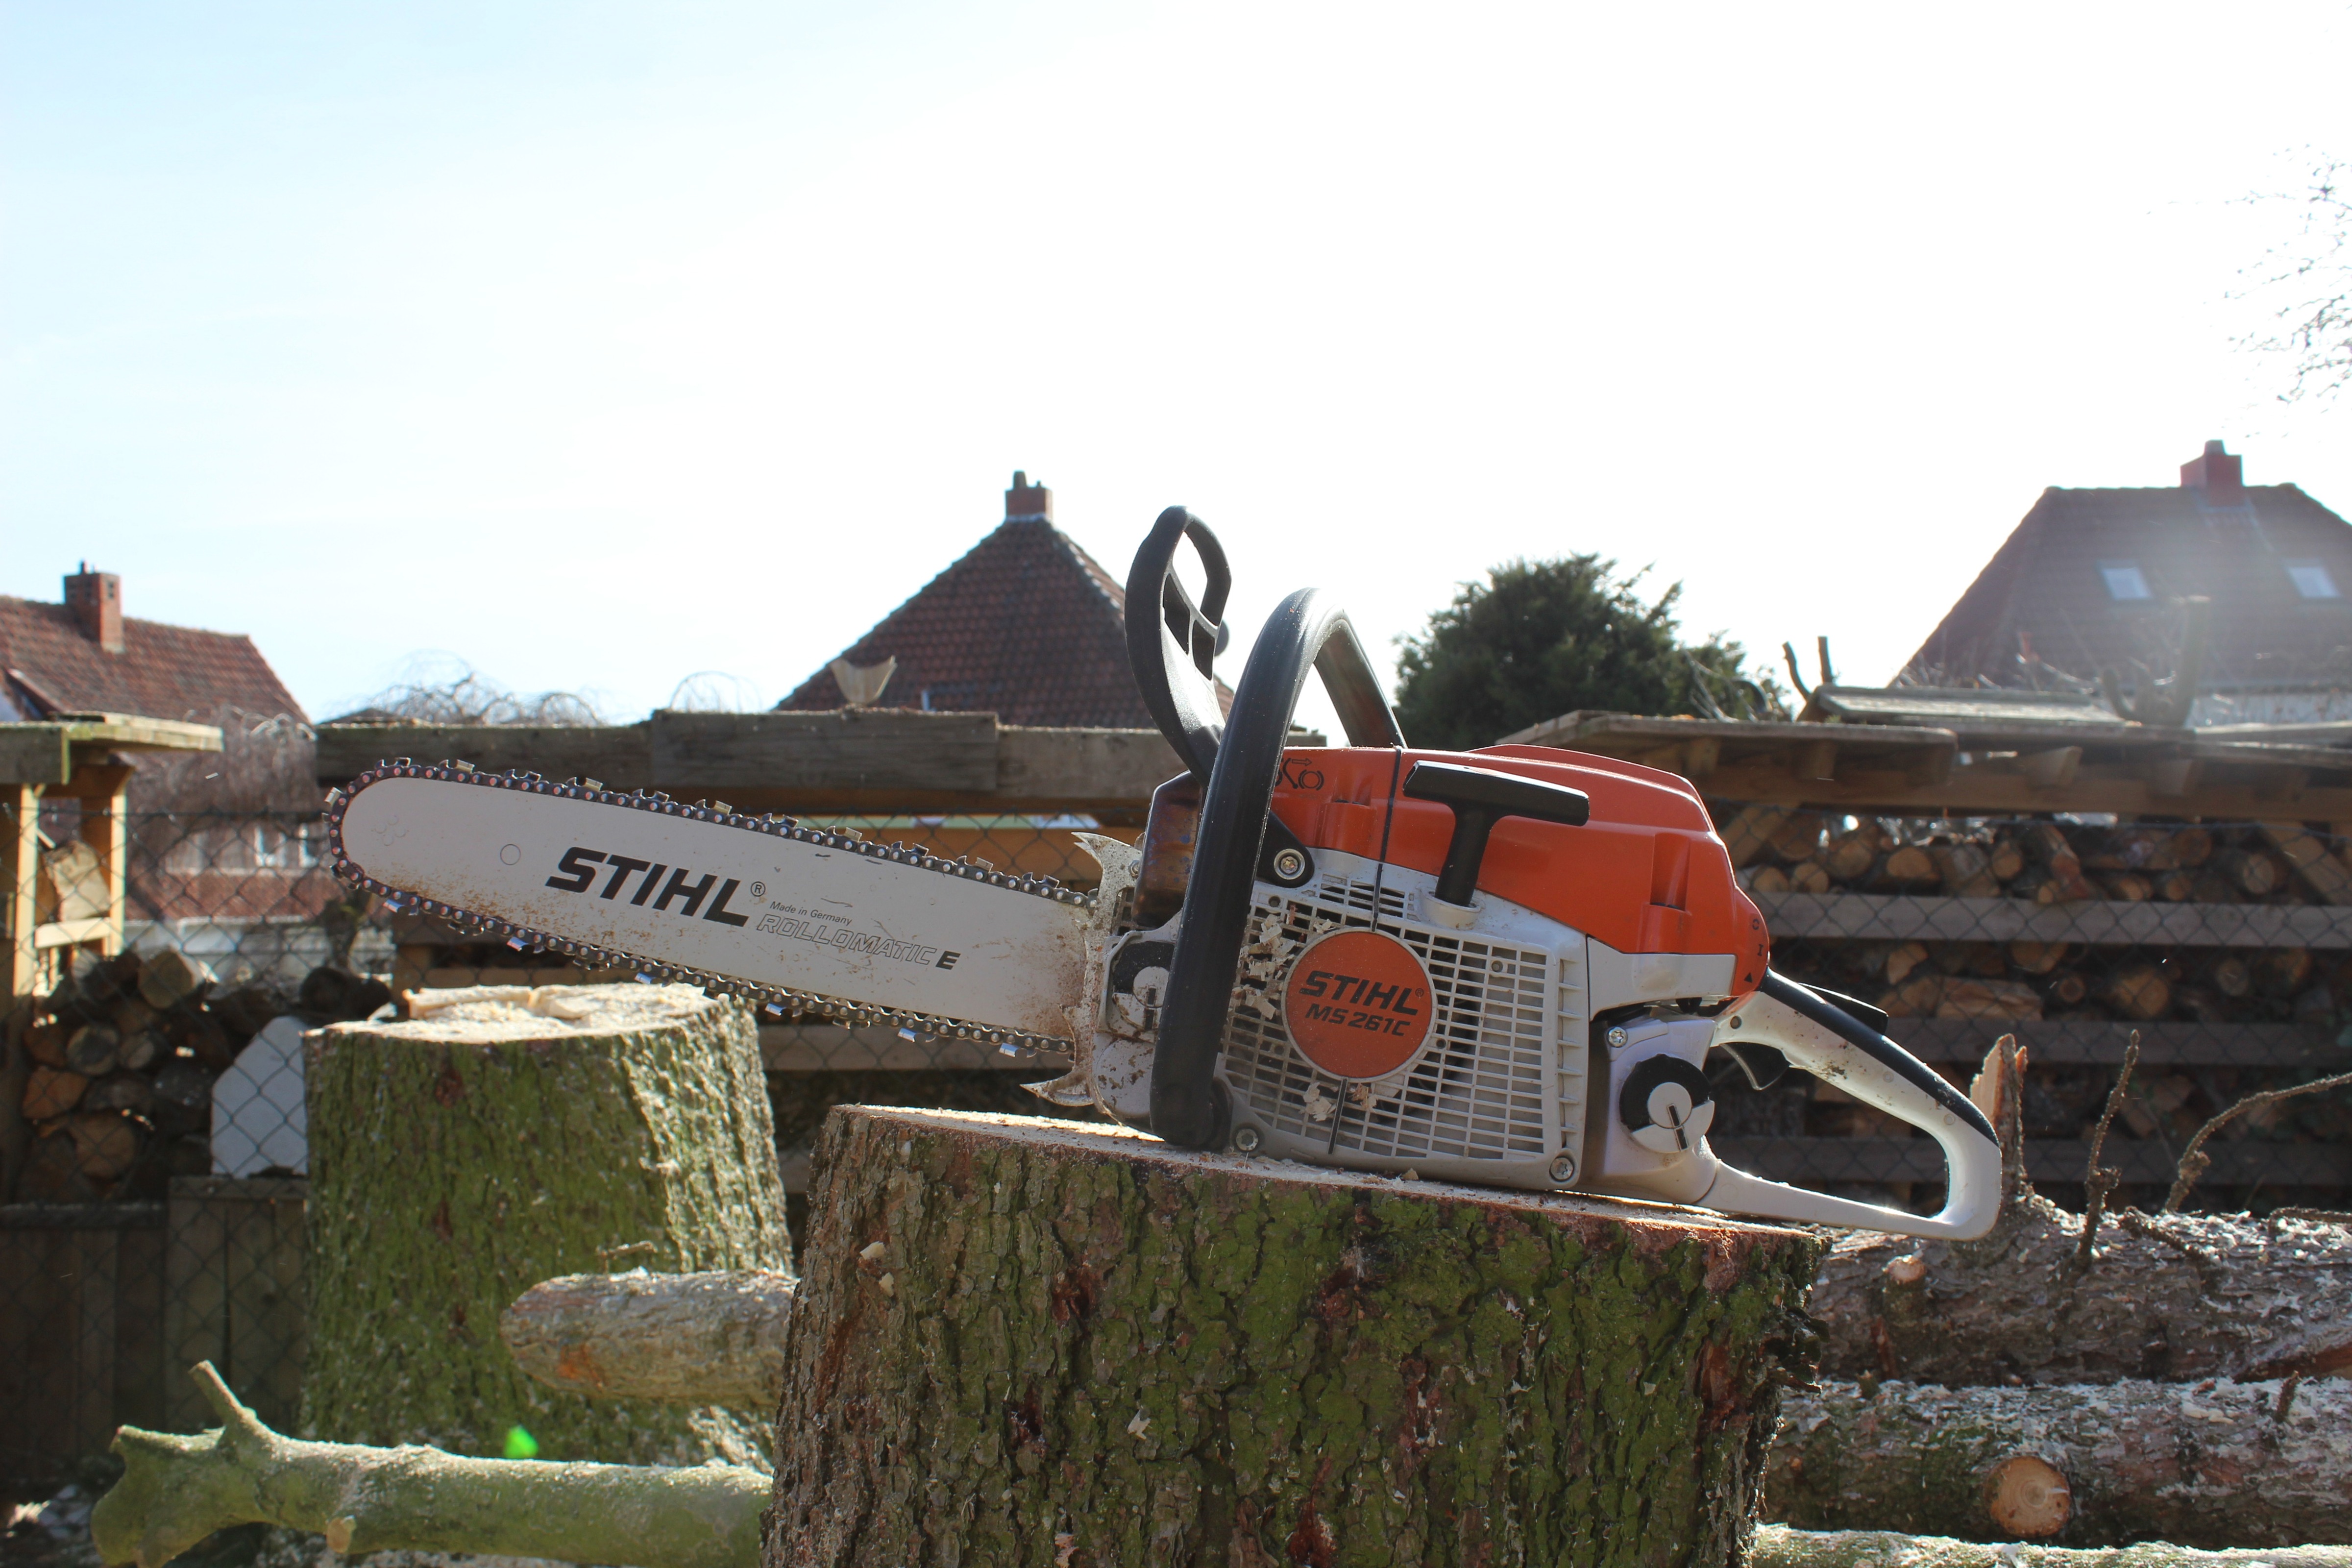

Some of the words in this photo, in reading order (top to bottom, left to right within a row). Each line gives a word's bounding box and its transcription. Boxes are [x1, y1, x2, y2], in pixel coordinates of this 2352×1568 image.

[545, 847, 750, 927] STIHL
[769, 901, 796, 913] Made
[798, 906, 808, 916] in
[810, 909, 853, 926] Germany
[756, 913, 937, 965] ROLLOMATIC
[935, 950, 961, 970] E
[1299, 970, 1419, 1016] STIHL
